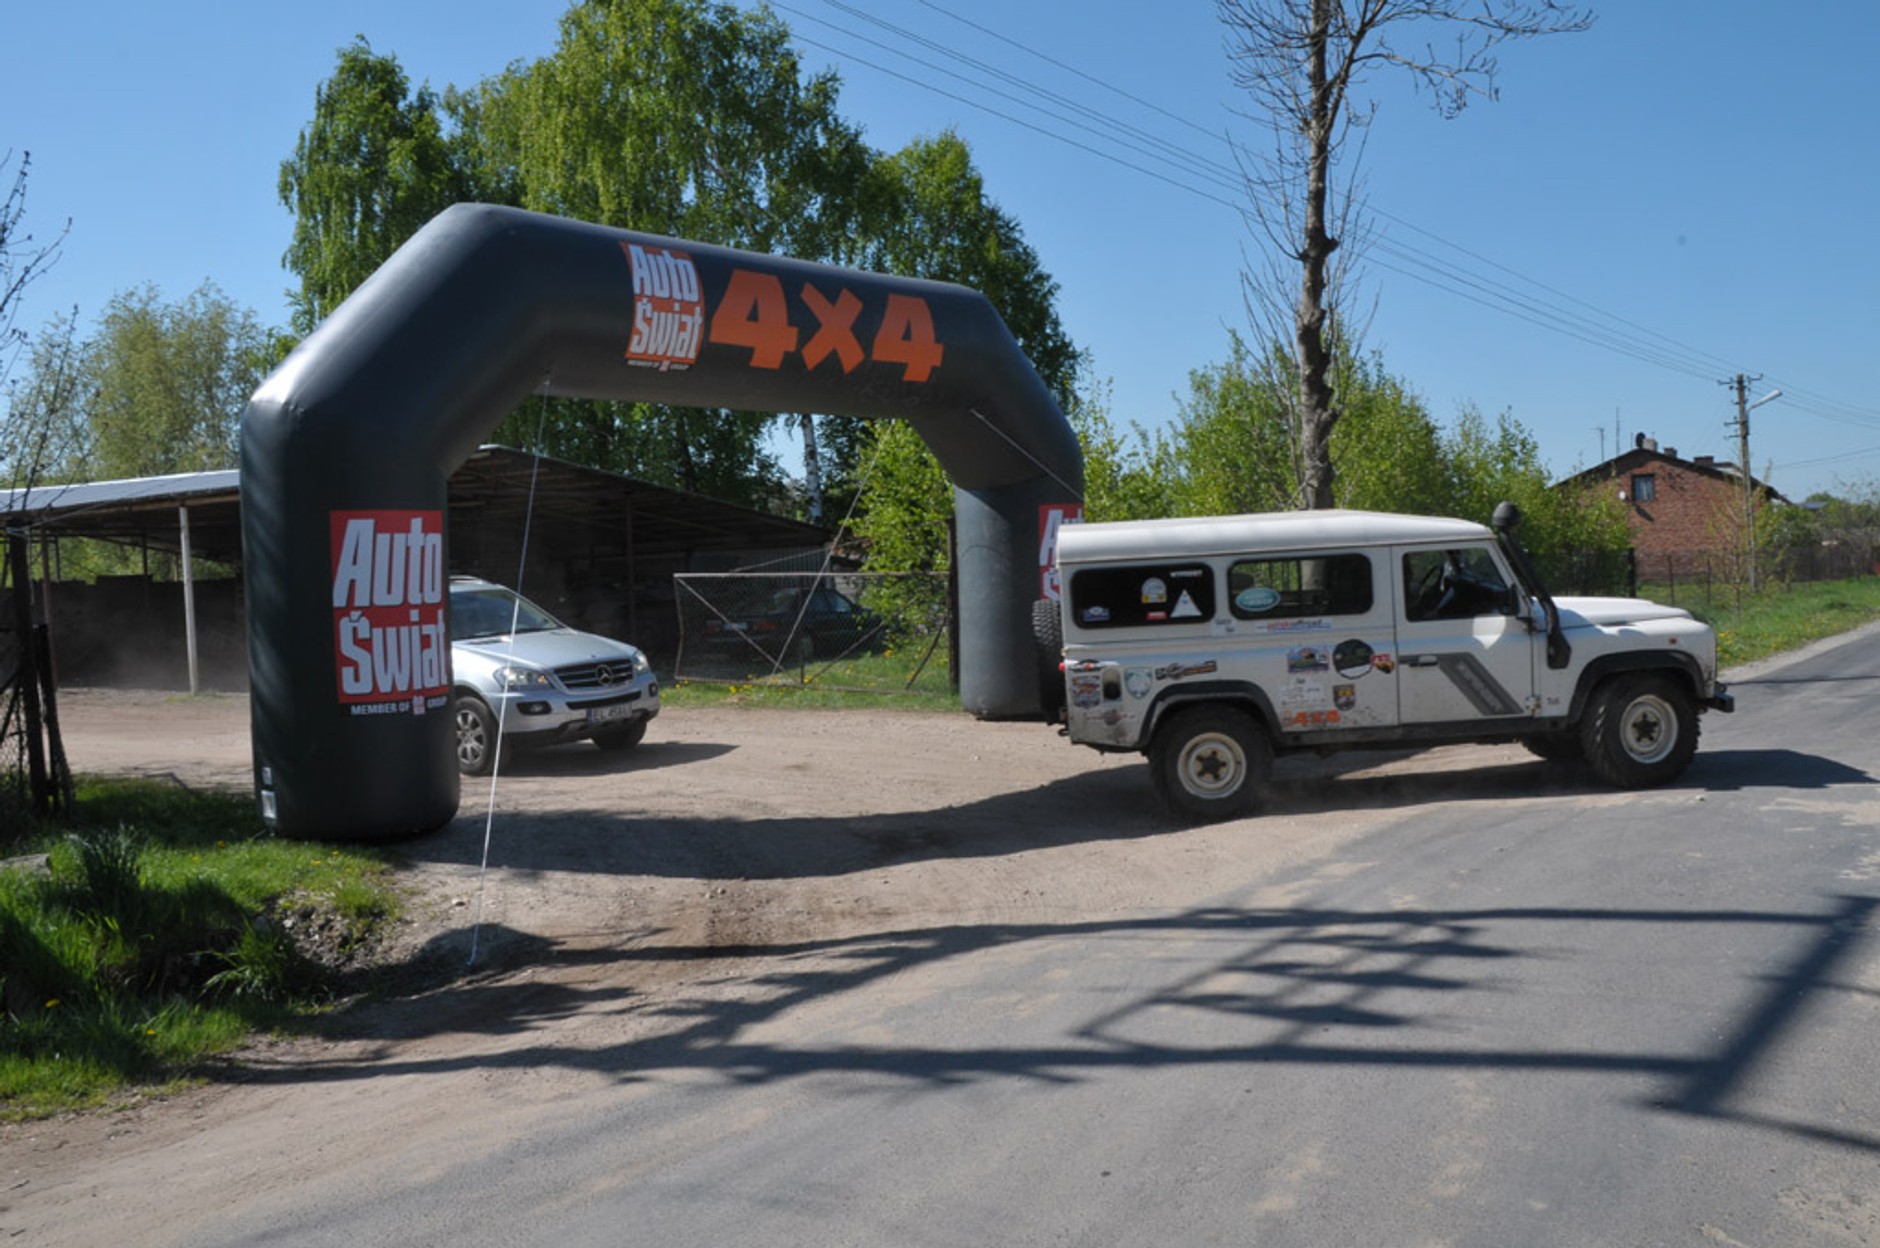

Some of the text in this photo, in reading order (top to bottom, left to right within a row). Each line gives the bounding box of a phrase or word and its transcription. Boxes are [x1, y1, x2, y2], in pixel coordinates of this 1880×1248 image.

[628, 244, 699, 302] Auto
[629, 297, 703, 359] Świat
[332, 517, 442, 607] Auto
[339, 609, 448, 695] Świat
[351, 703, 397, 715] MEMBER
[399, 702, 410, 713] OF
